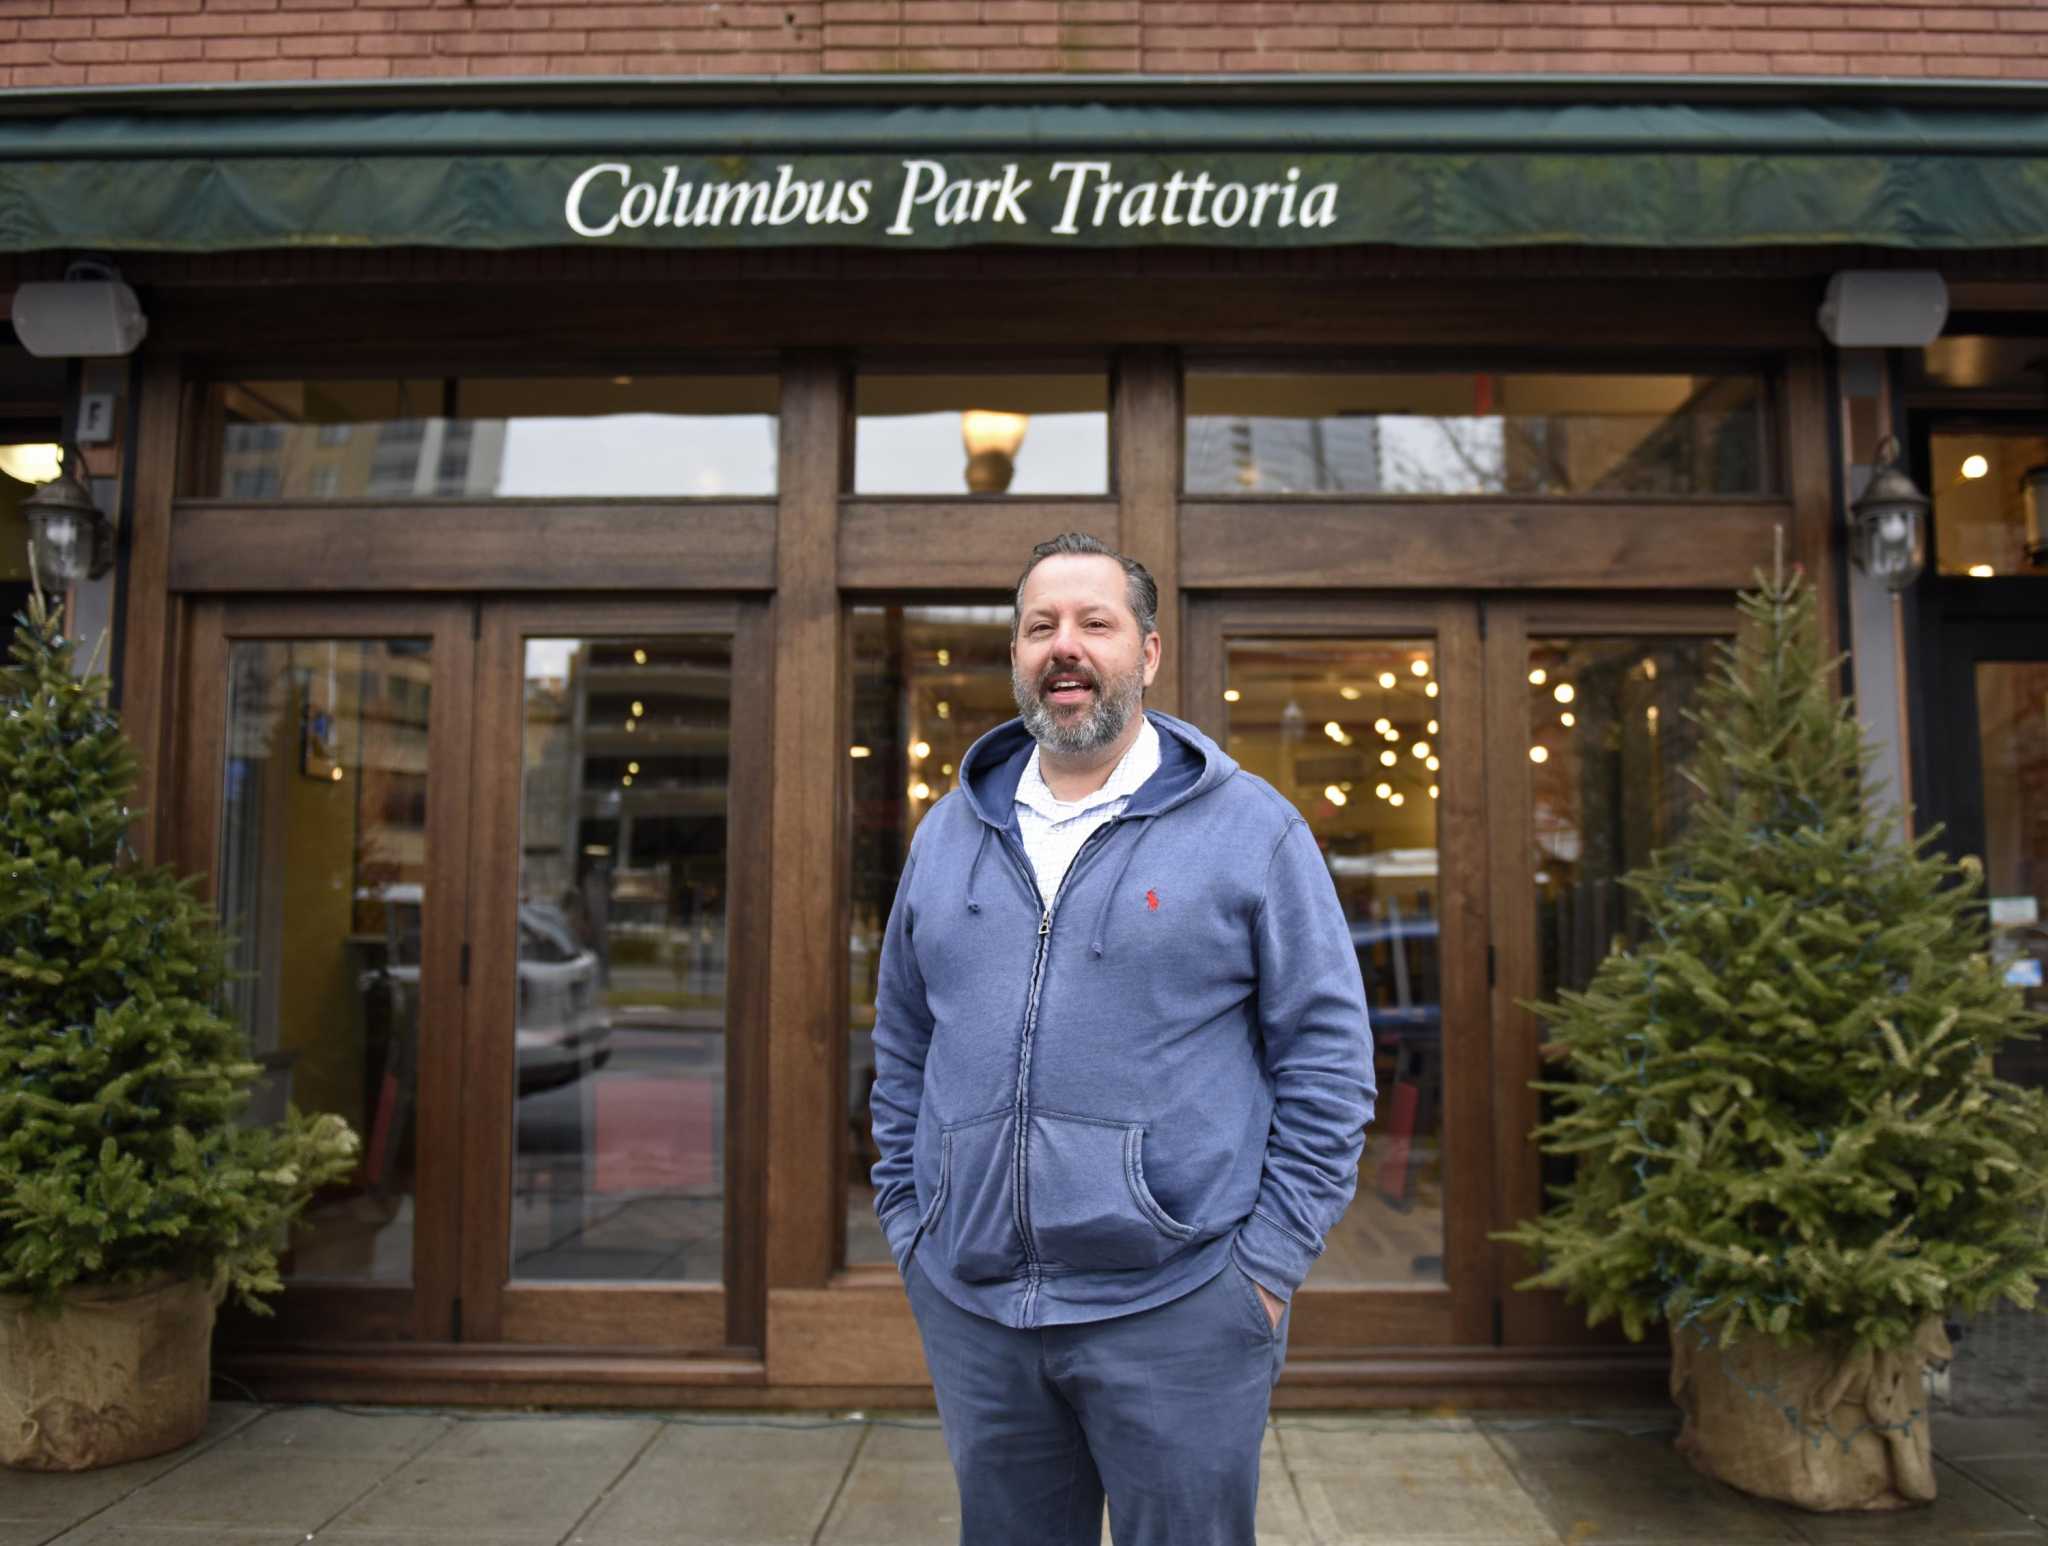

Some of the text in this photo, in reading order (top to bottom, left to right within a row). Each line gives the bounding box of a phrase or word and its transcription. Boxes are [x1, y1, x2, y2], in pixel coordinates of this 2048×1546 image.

[565, 160, 1338, 236] Columbus Park Trattoria
